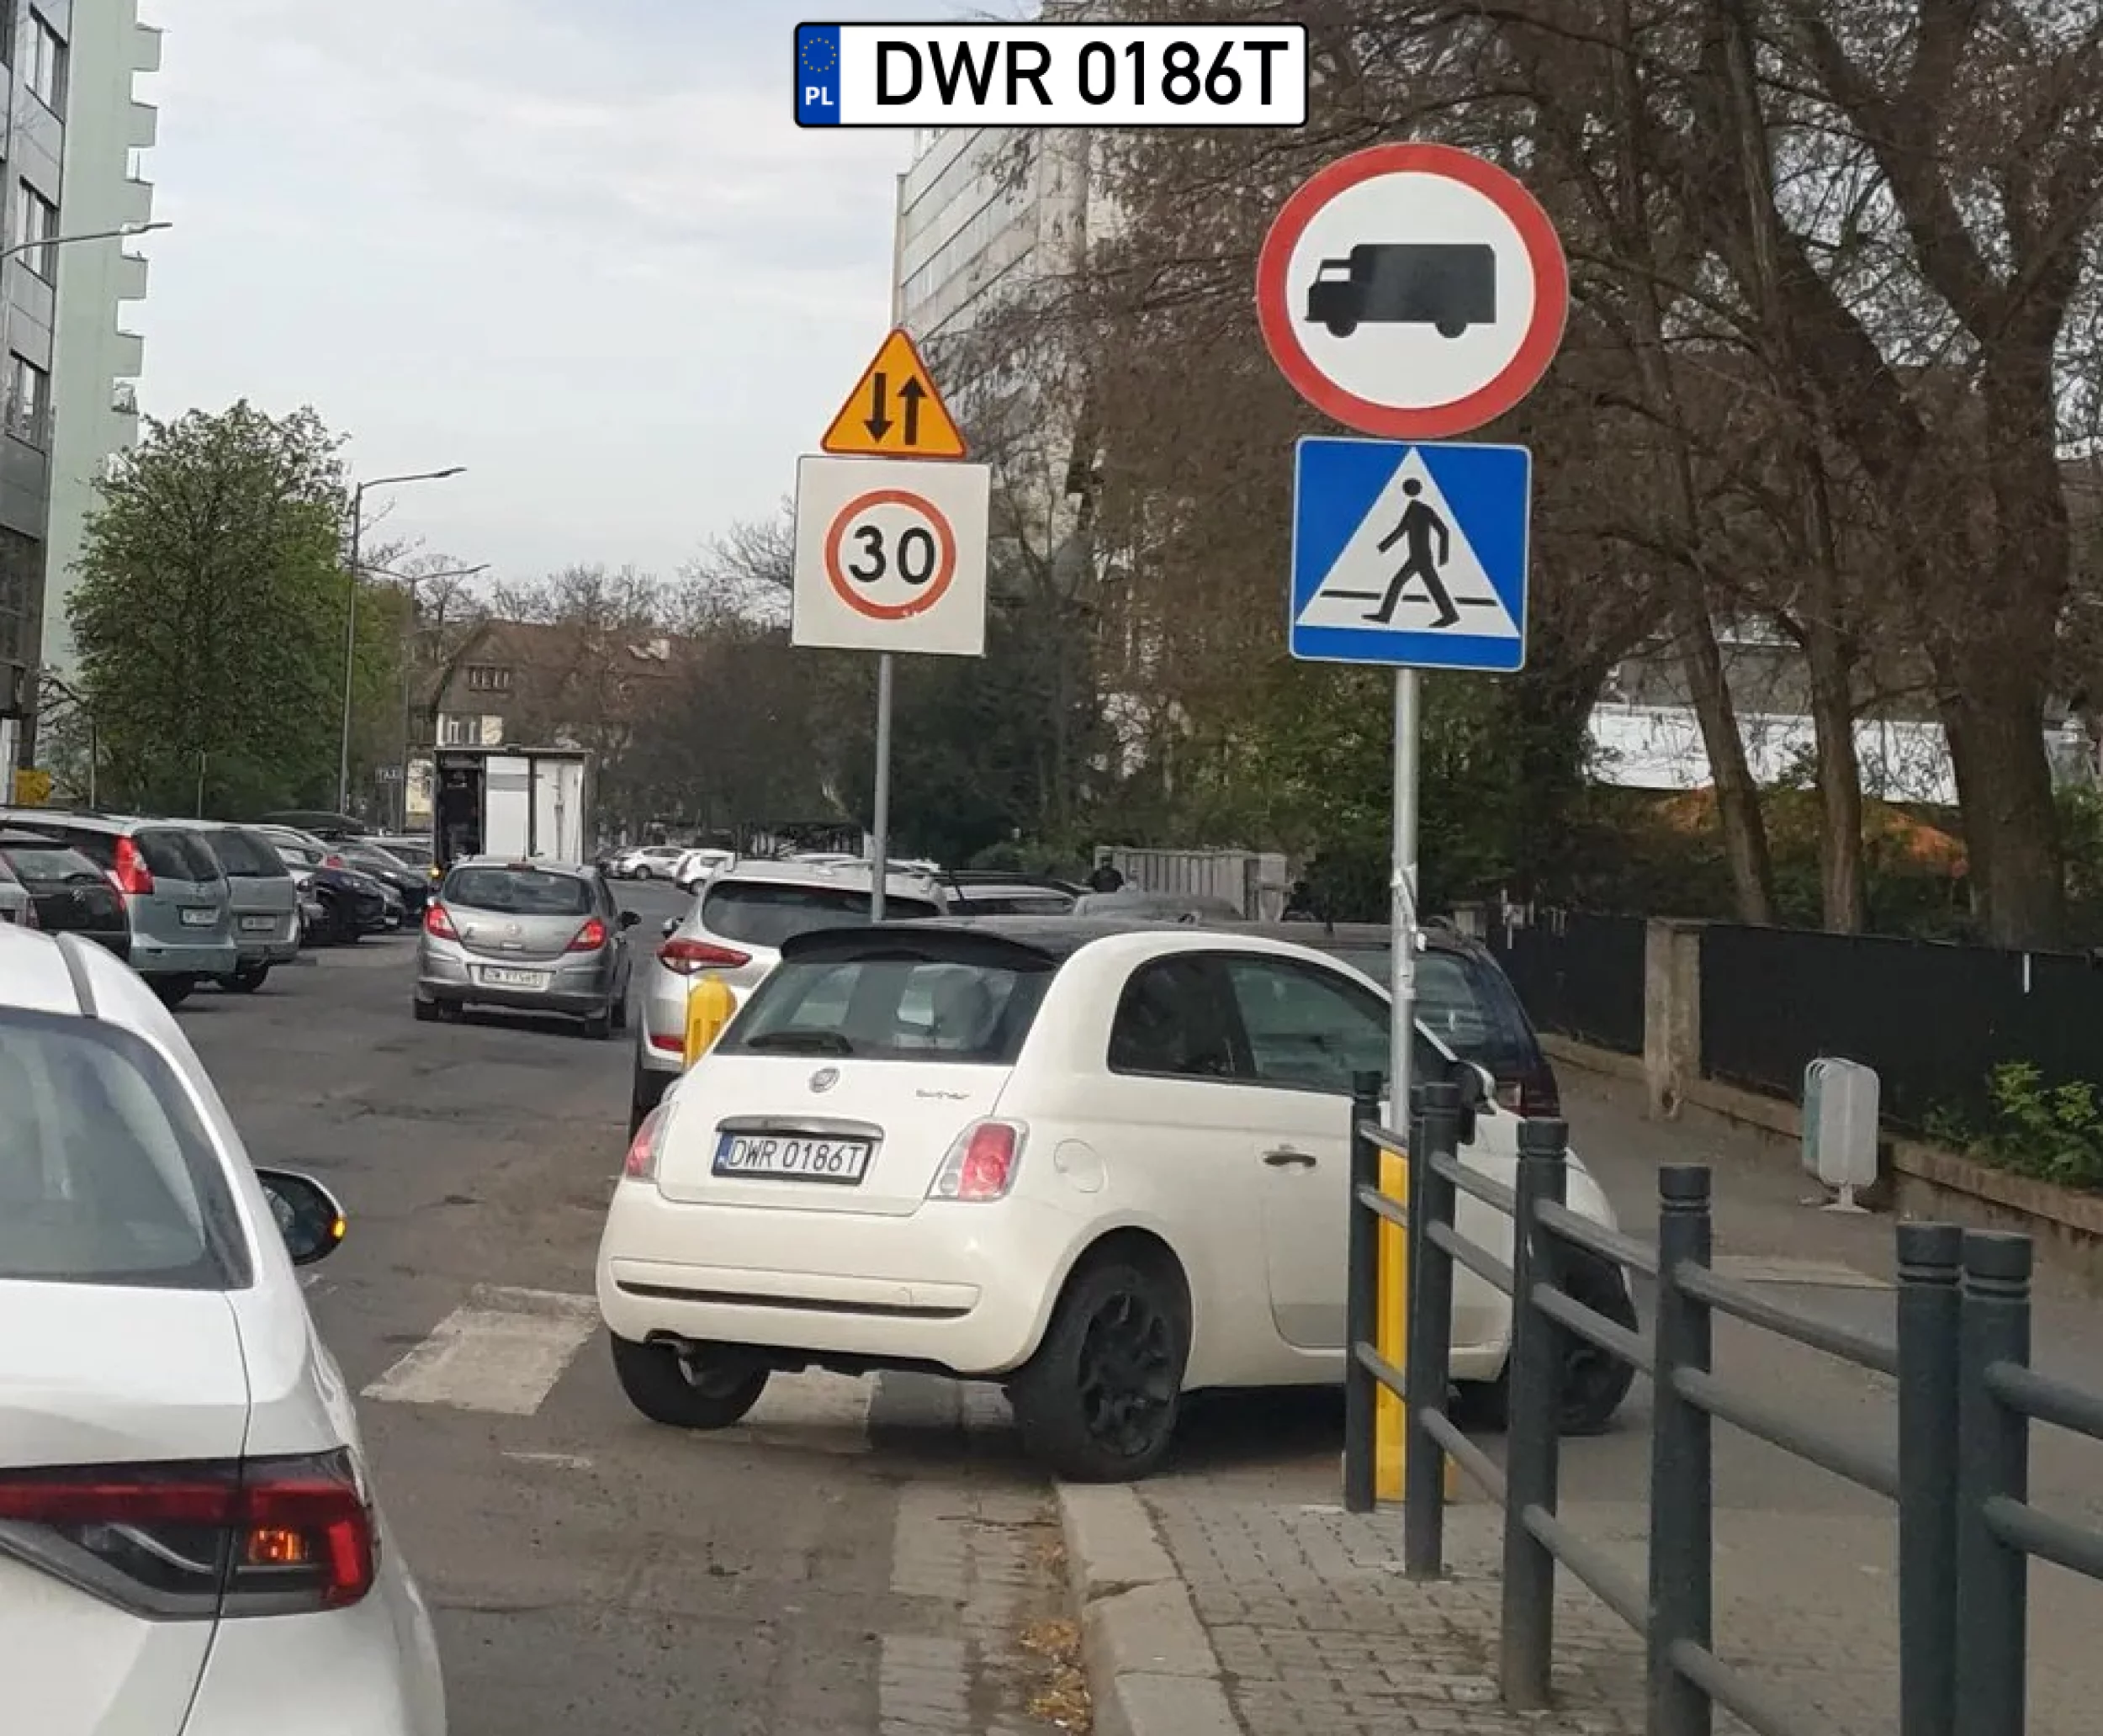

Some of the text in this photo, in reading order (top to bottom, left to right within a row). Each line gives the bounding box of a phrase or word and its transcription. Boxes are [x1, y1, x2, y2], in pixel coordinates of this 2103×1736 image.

[849, 525, 935, 585] 30
[728, 1140, 864, 1173] DWR 0186T
